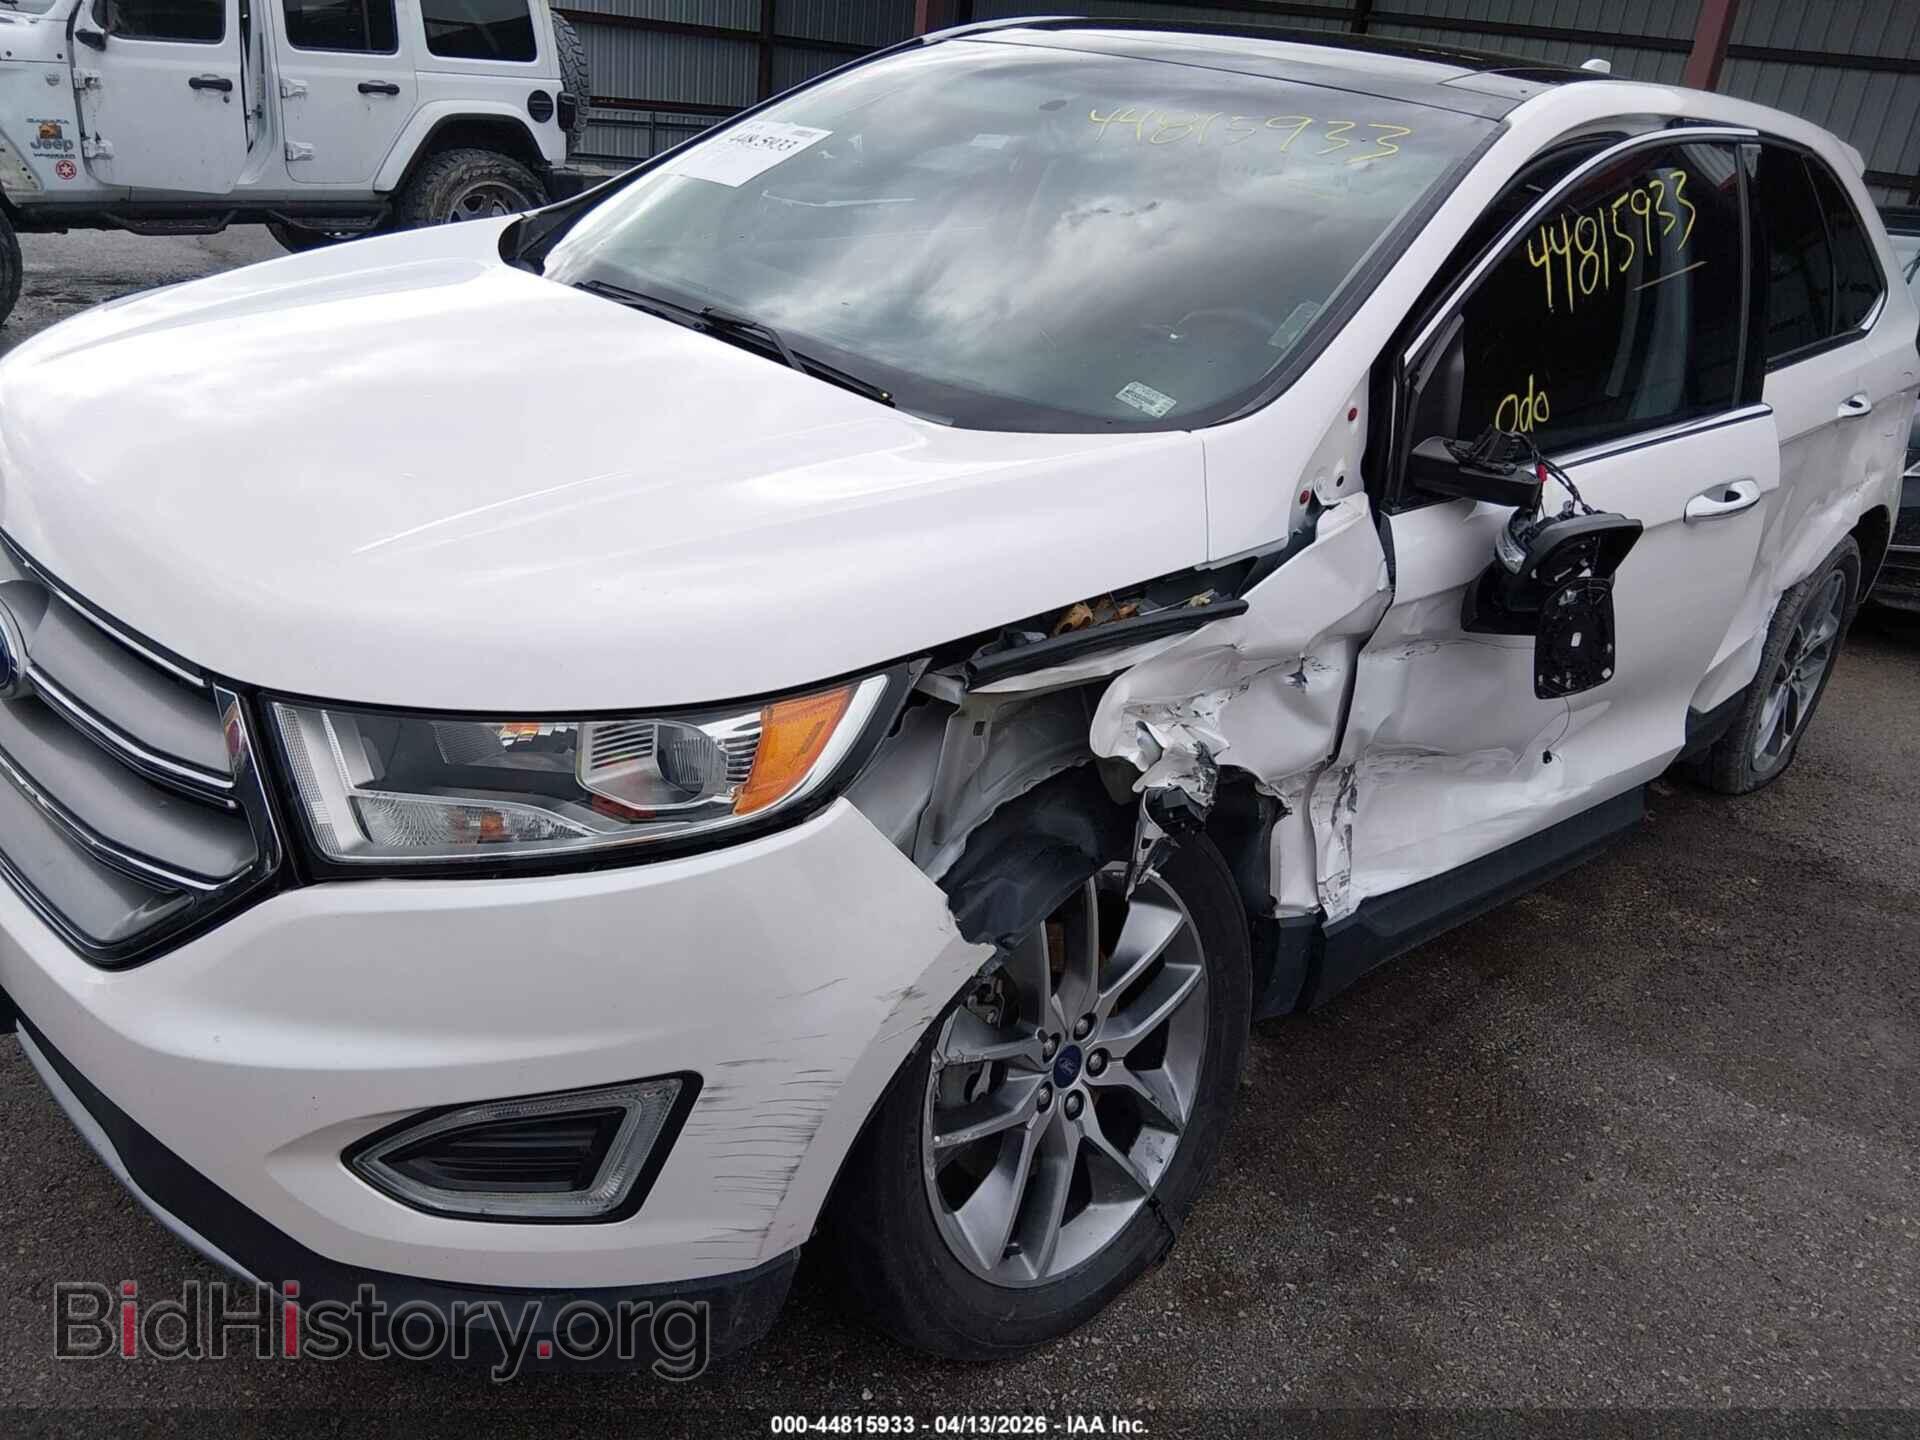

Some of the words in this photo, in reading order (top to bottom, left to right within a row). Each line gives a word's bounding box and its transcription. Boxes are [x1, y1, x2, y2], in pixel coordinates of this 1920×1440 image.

[30, 136, 74, 152] Jeep
[1089, 108, 1412, 166] 44815933
[1527, 170, 1696, 313] 44815933
